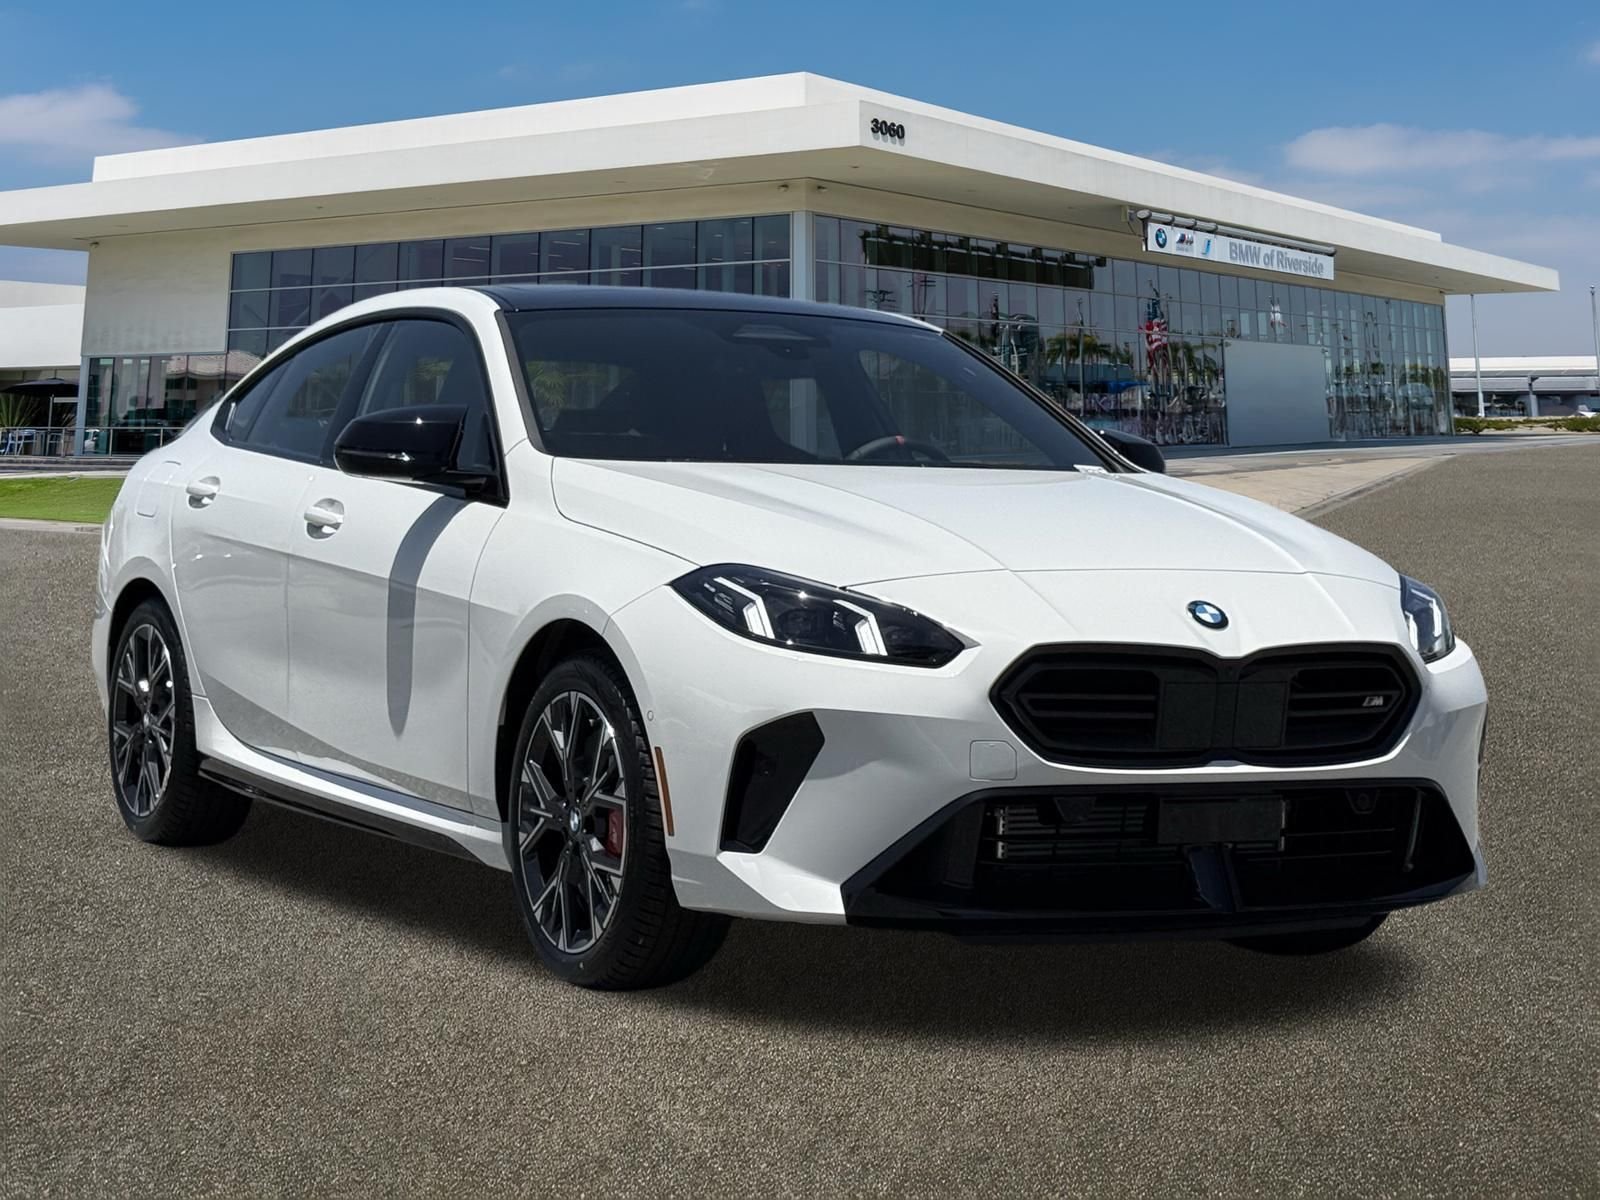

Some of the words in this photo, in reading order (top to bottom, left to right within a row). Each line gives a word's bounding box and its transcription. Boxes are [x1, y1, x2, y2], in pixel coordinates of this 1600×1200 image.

[871, 118, 905, 140] 3060
[1229, 241, 1261, 265] BMW
[1263, 249, 1275, 268] of
[1276, 250, 1325, 275] Riverside
